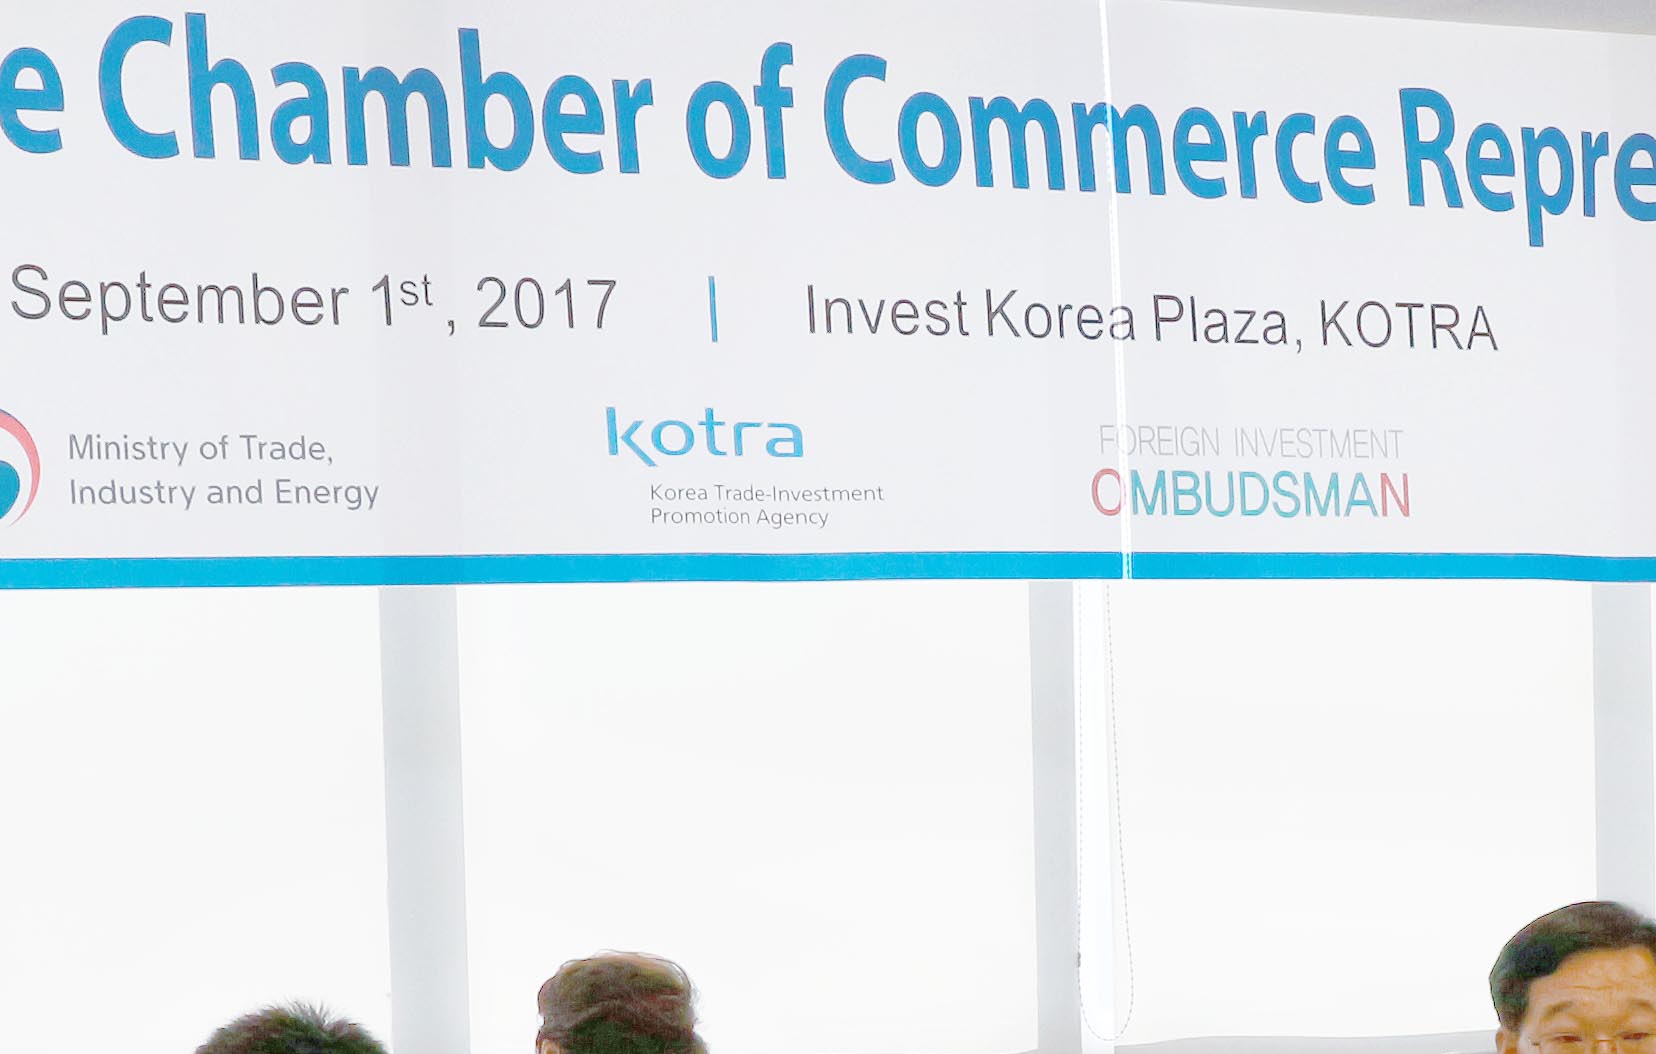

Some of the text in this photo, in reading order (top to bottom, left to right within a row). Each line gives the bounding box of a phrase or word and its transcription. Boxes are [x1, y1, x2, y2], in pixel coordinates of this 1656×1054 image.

[98, 12, 654, 175] Chamber
[686, 41, 794, 180] of
[823, 53, 1377, 205] Commerce
[11, 263, 349, 336] September
[477, 275, 618, 330] 2017
[806, 284, 970, 337] Invest
[986, 288, 1136, 342] Korea
[1153, 294, 1304, 354] Plaza,
[1319, 299, 1499, 352] KOTRA
[68, 433, 334, 466] Ministry of Trade,
[605, 406, 805, 467] kotra
[1098, 424, 1405, 460] FOREIGN INVESTMENT
[70, 478, 380, 511] Industry and Energy
[650, 483, 885, 502] Korea Trade-Investment
[1090, 467, 1411, 519] OMBUDSMAN
[651, 506, 830, 530] Promotion Agency
